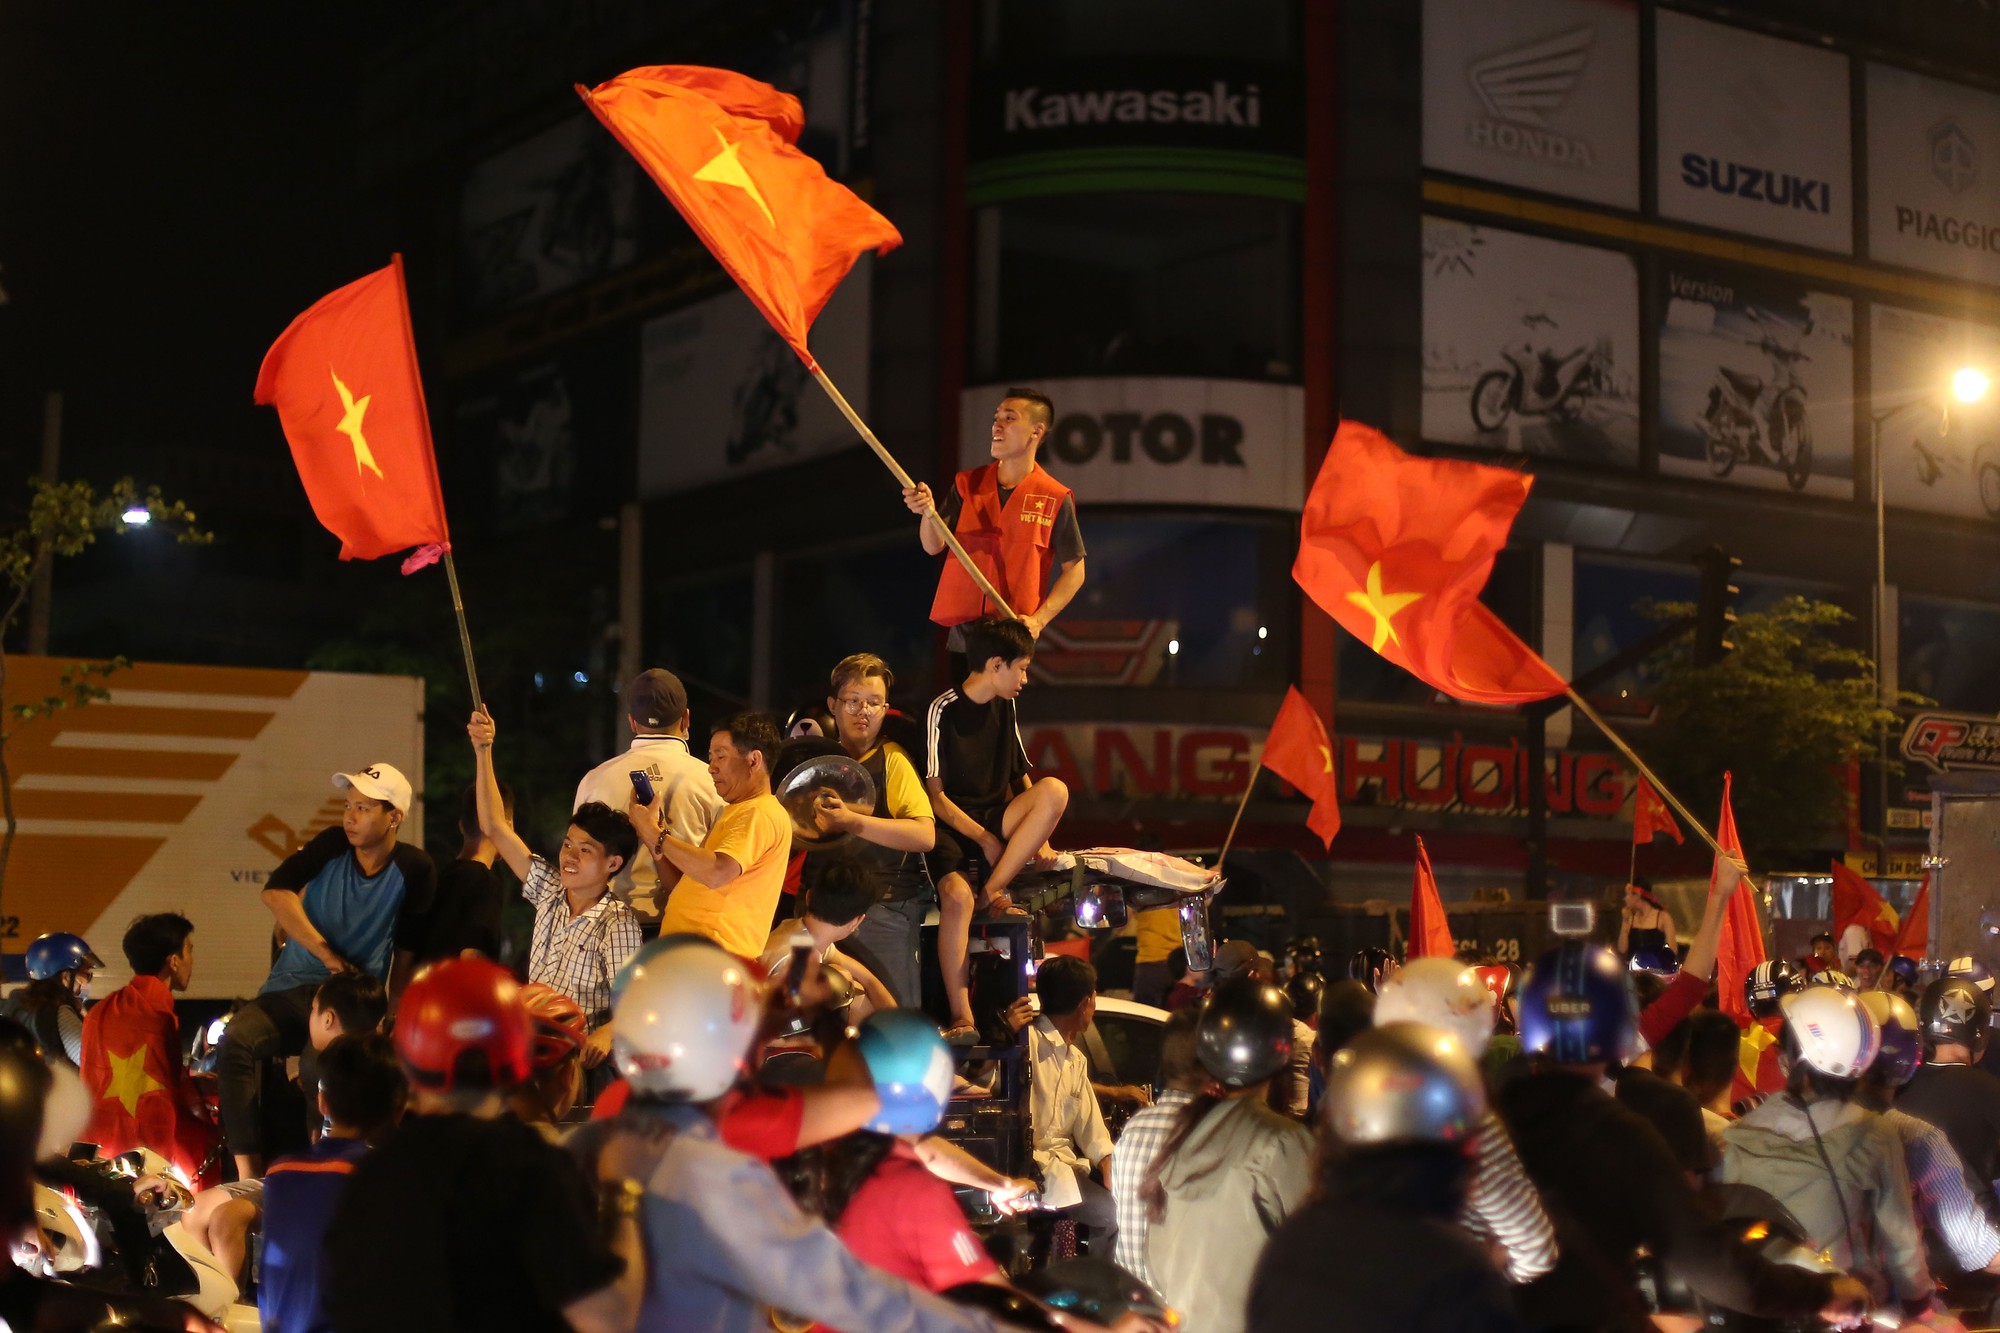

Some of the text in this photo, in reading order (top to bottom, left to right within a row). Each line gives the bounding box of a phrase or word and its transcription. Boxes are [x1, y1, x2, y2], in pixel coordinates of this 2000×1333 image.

[1004, 80, 1261, 132] Kawasaki
[1470, 120, 1595, 168] HONDA
[1682, 152, 1831, 214] SUZUKI
[1669, 271, 1735, 304] Version
[1036, 411, 1246, 469] OTOR
[1024, 730, 1625, 814] ANG HƯƠNG
[1496, 938, 1520, 962] 28
[1550, 1002, 1591, 1014] UBER
